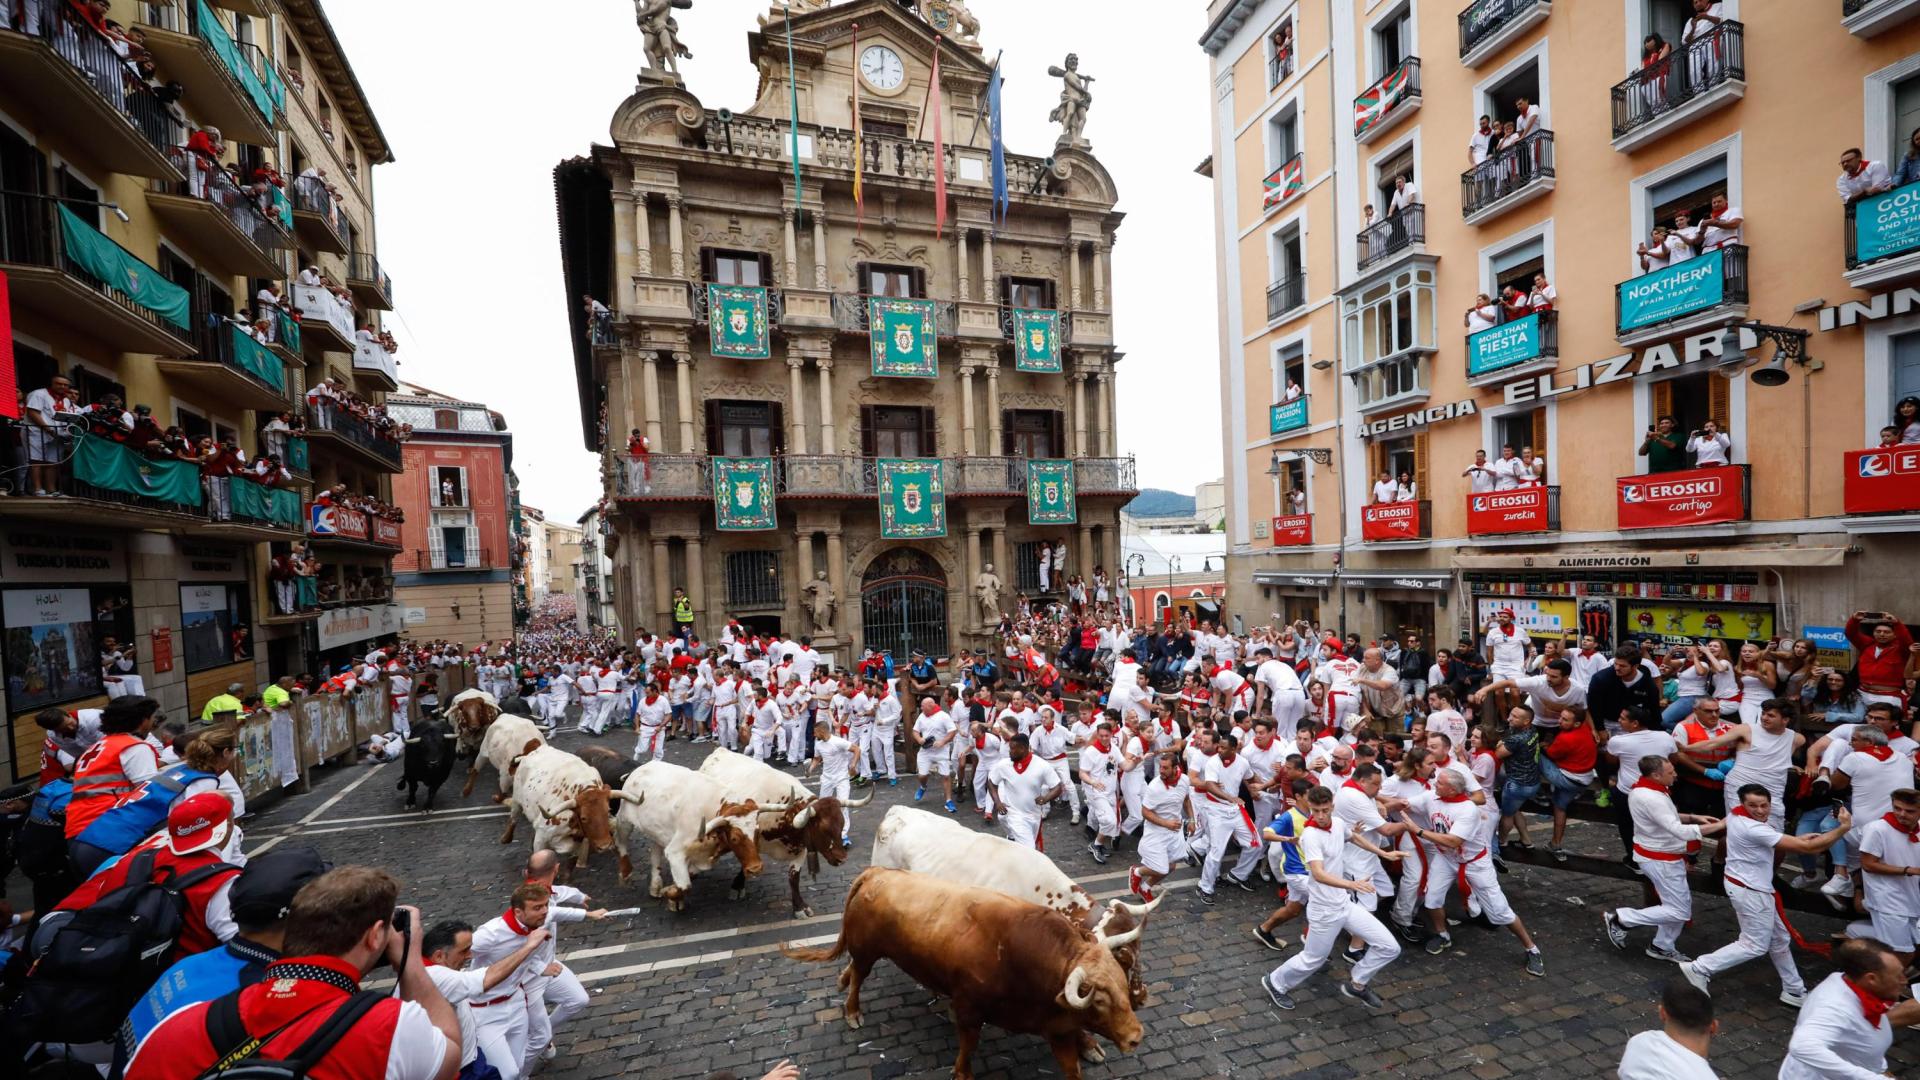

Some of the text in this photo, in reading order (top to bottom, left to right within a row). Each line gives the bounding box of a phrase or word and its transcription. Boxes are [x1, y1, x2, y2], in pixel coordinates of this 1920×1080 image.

[1877, 221, 1900, 232] AND
[1629, 264, 1712, 300] NORTHERN
[1639, 286, 1699, 307] SPAIN TRAVEL
[1478, 322, 1528, 345] MORE THAN
[1479, 332, 1528, 356] FIESTA
[1356, 399, 1476, 439] AGENCIA
[1650, 481, 1715, 498] EROSKI
[1490, 494, 1535, 508] EROSKI
[1668, 498, 1712, 516] contigo
[1378, 508, 1410, 518] EROSKI
[1503, 510, 1536, 521] zurekin
[1283, 519, 1306, 527] EROSKI
[1388, 518, 1409, 530] contigo
[1558, 555, 1651, 567] ALIMENTACIÓN
[218, 1039, 260, 1070] Nikon
